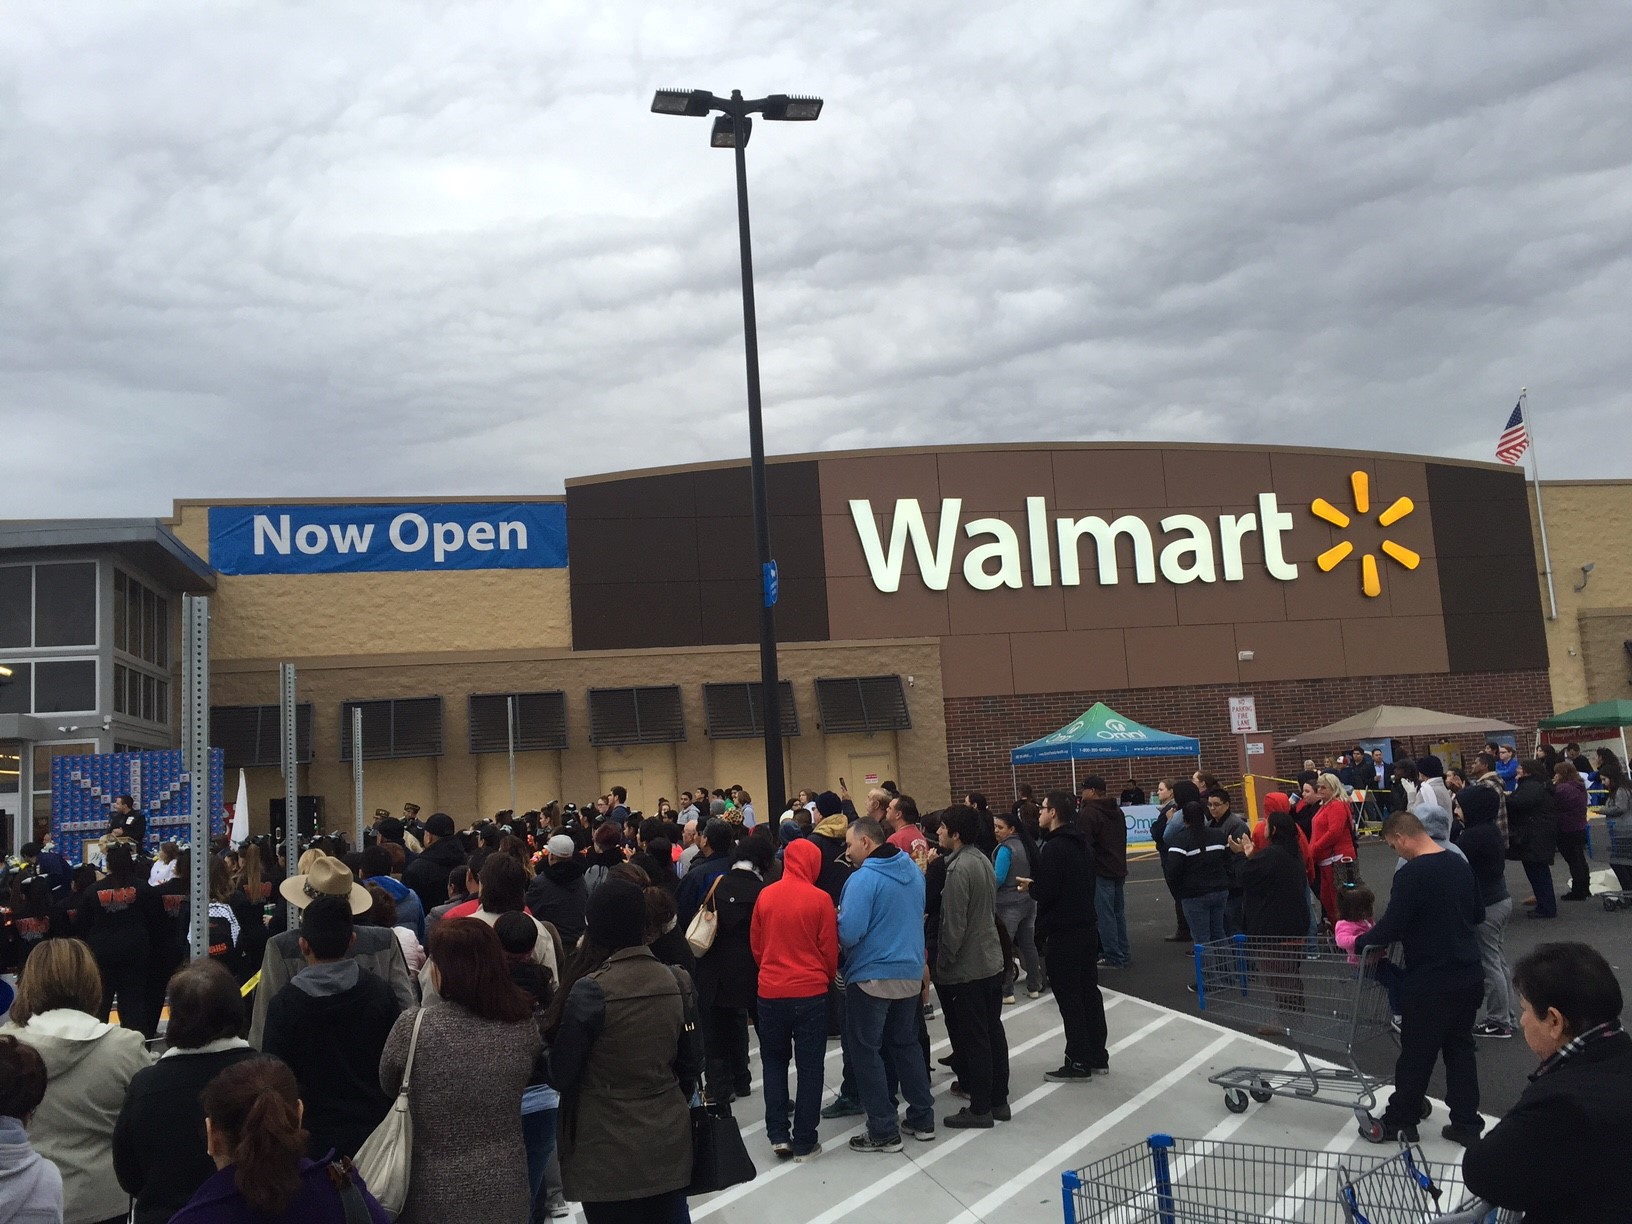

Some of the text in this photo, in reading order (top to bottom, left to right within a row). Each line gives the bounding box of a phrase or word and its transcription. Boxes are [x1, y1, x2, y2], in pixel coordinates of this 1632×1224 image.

[253, 512, 529, 563] Now Open
[849, 492, 1299, 594] Walmart
